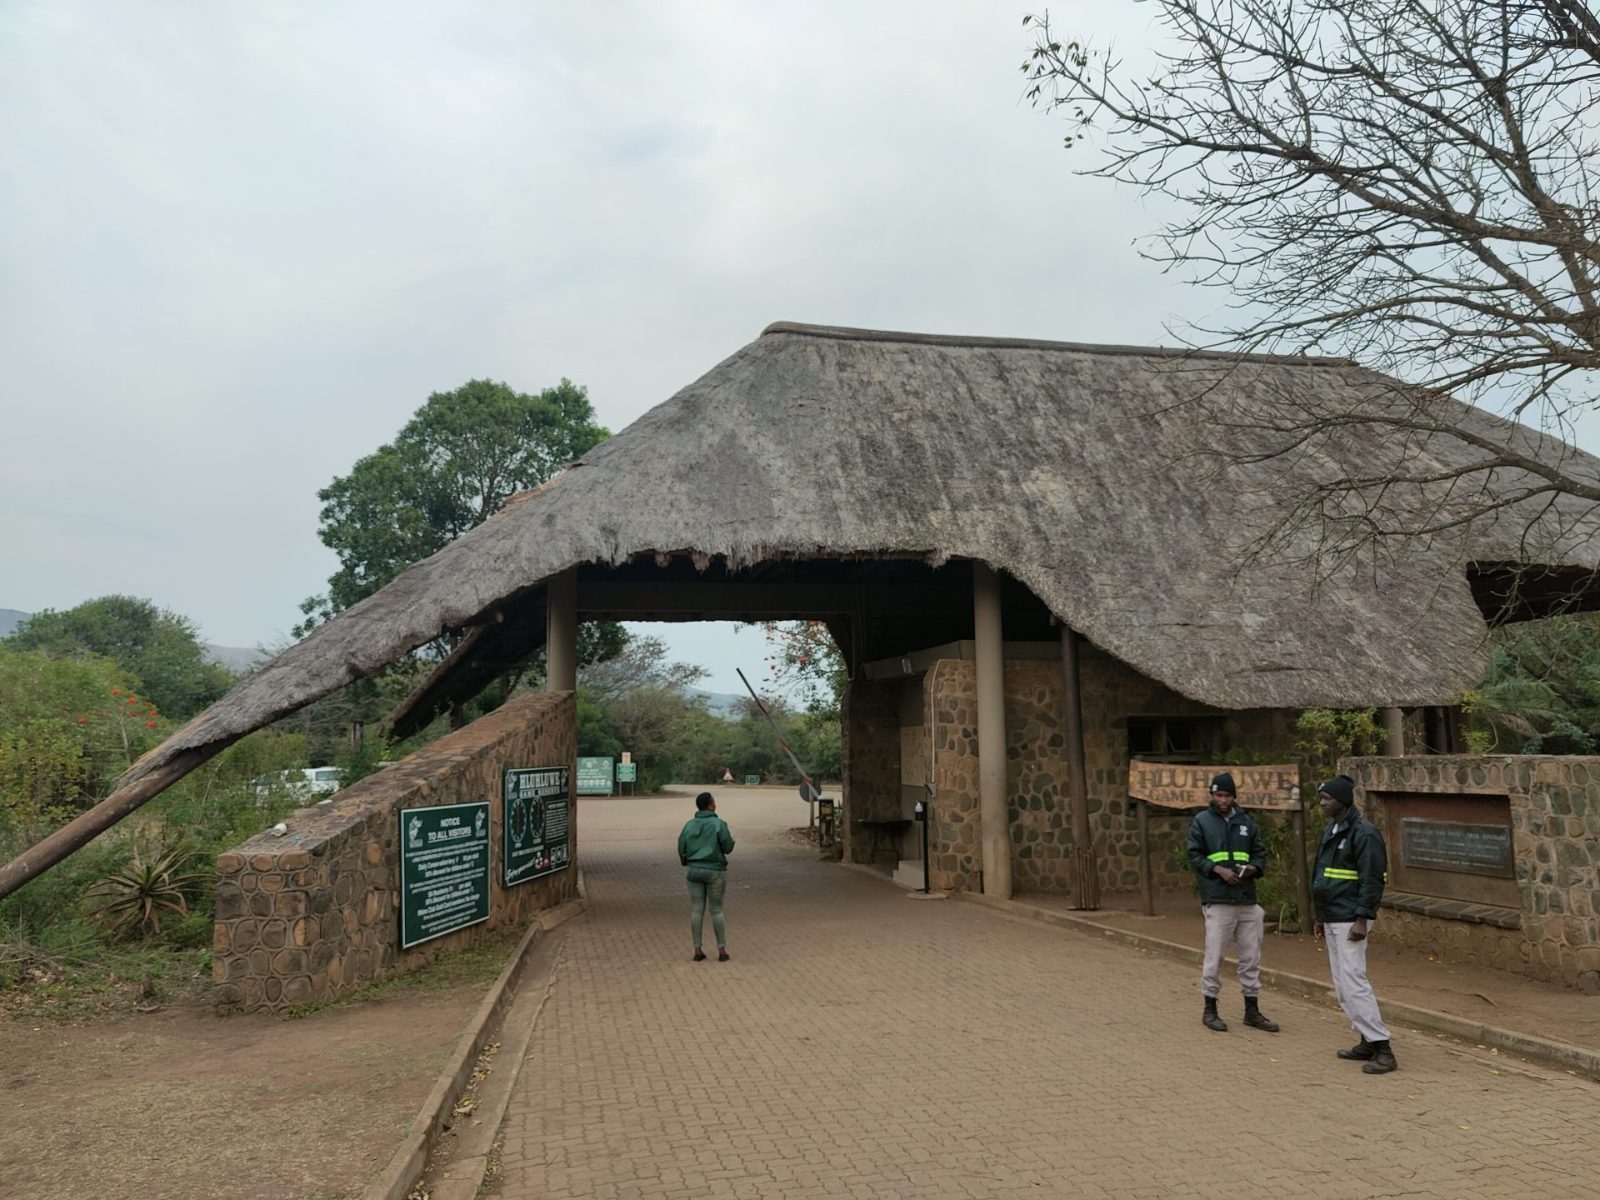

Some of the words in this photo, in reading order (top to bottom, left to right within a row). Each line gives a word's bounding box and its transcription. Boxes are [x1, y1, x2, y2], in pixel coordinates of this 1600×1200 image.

[519, 772, 560, 789] HLUHLUWE
[1138, 768, 1293, 790] HLUHUWE
[519, 789, 536, 799] GAME
[1148, 790, 1196, 802] GAME
[440, 817, 460, 827] NOTICE
[428, 832, 436, 841] TO
[437, 830, 448, 839] ALL
[448, 826, 472, 838] VISITORS
